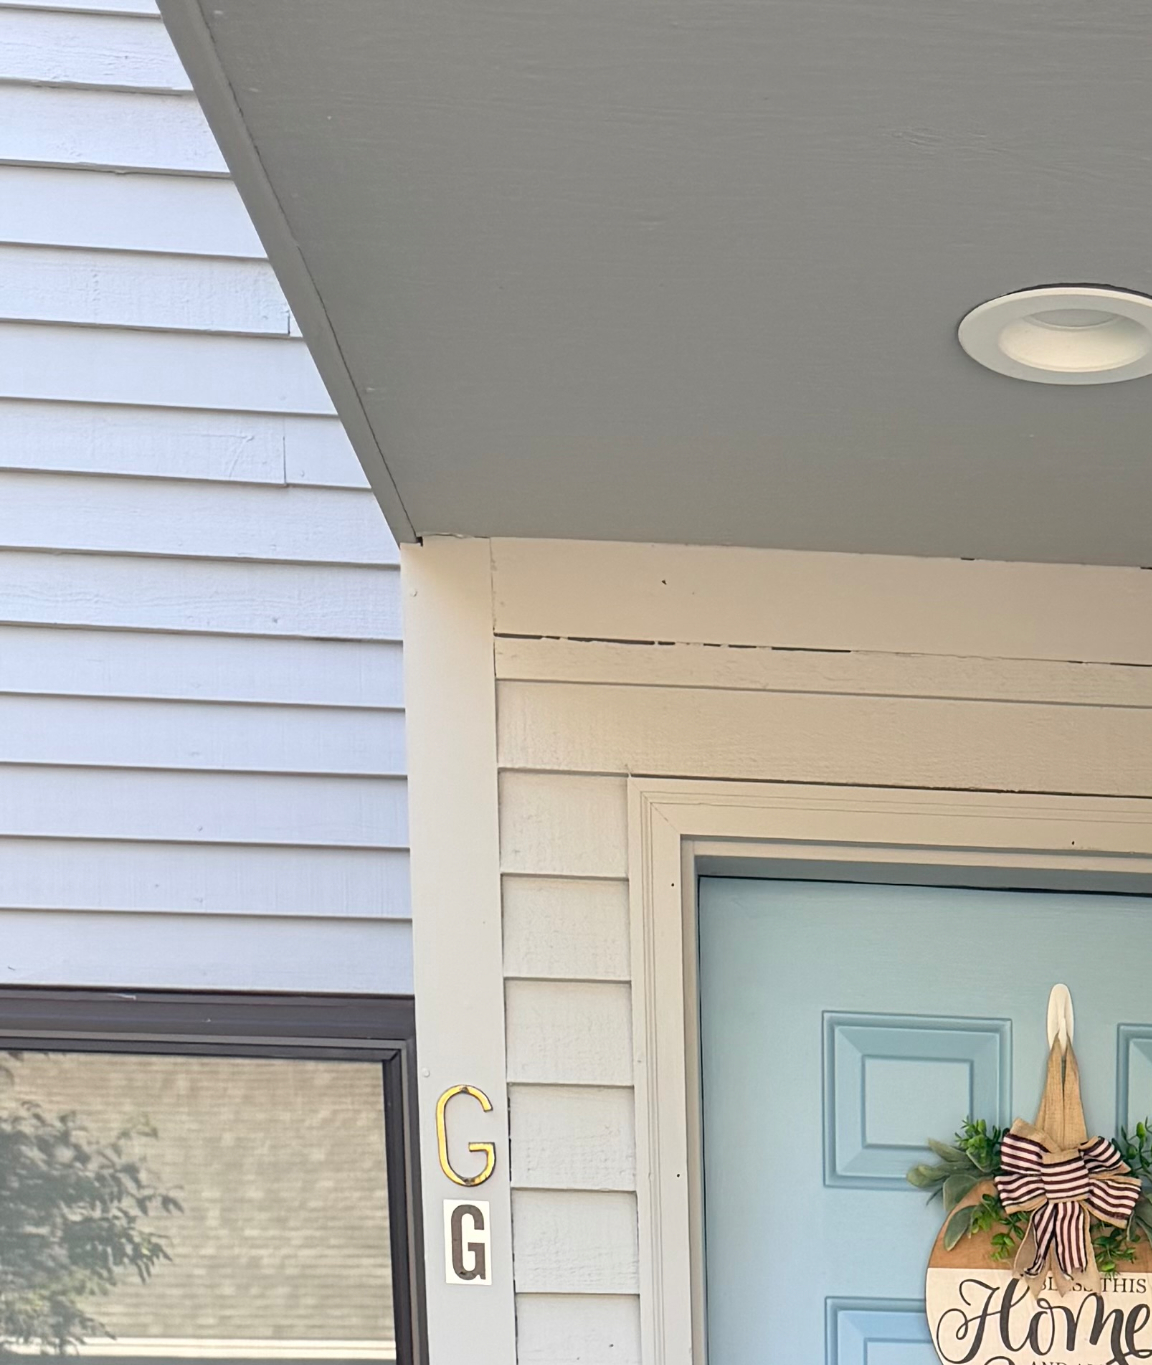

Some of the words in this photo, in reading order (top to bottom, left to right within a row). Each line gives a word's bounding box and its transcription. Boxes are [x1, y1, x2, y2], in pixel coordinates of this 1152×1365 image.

[435, 1084, 497, 1188] G
[450, 1204, 487, 1281] G
[1099, 1277, 1147, 1294] THIS
